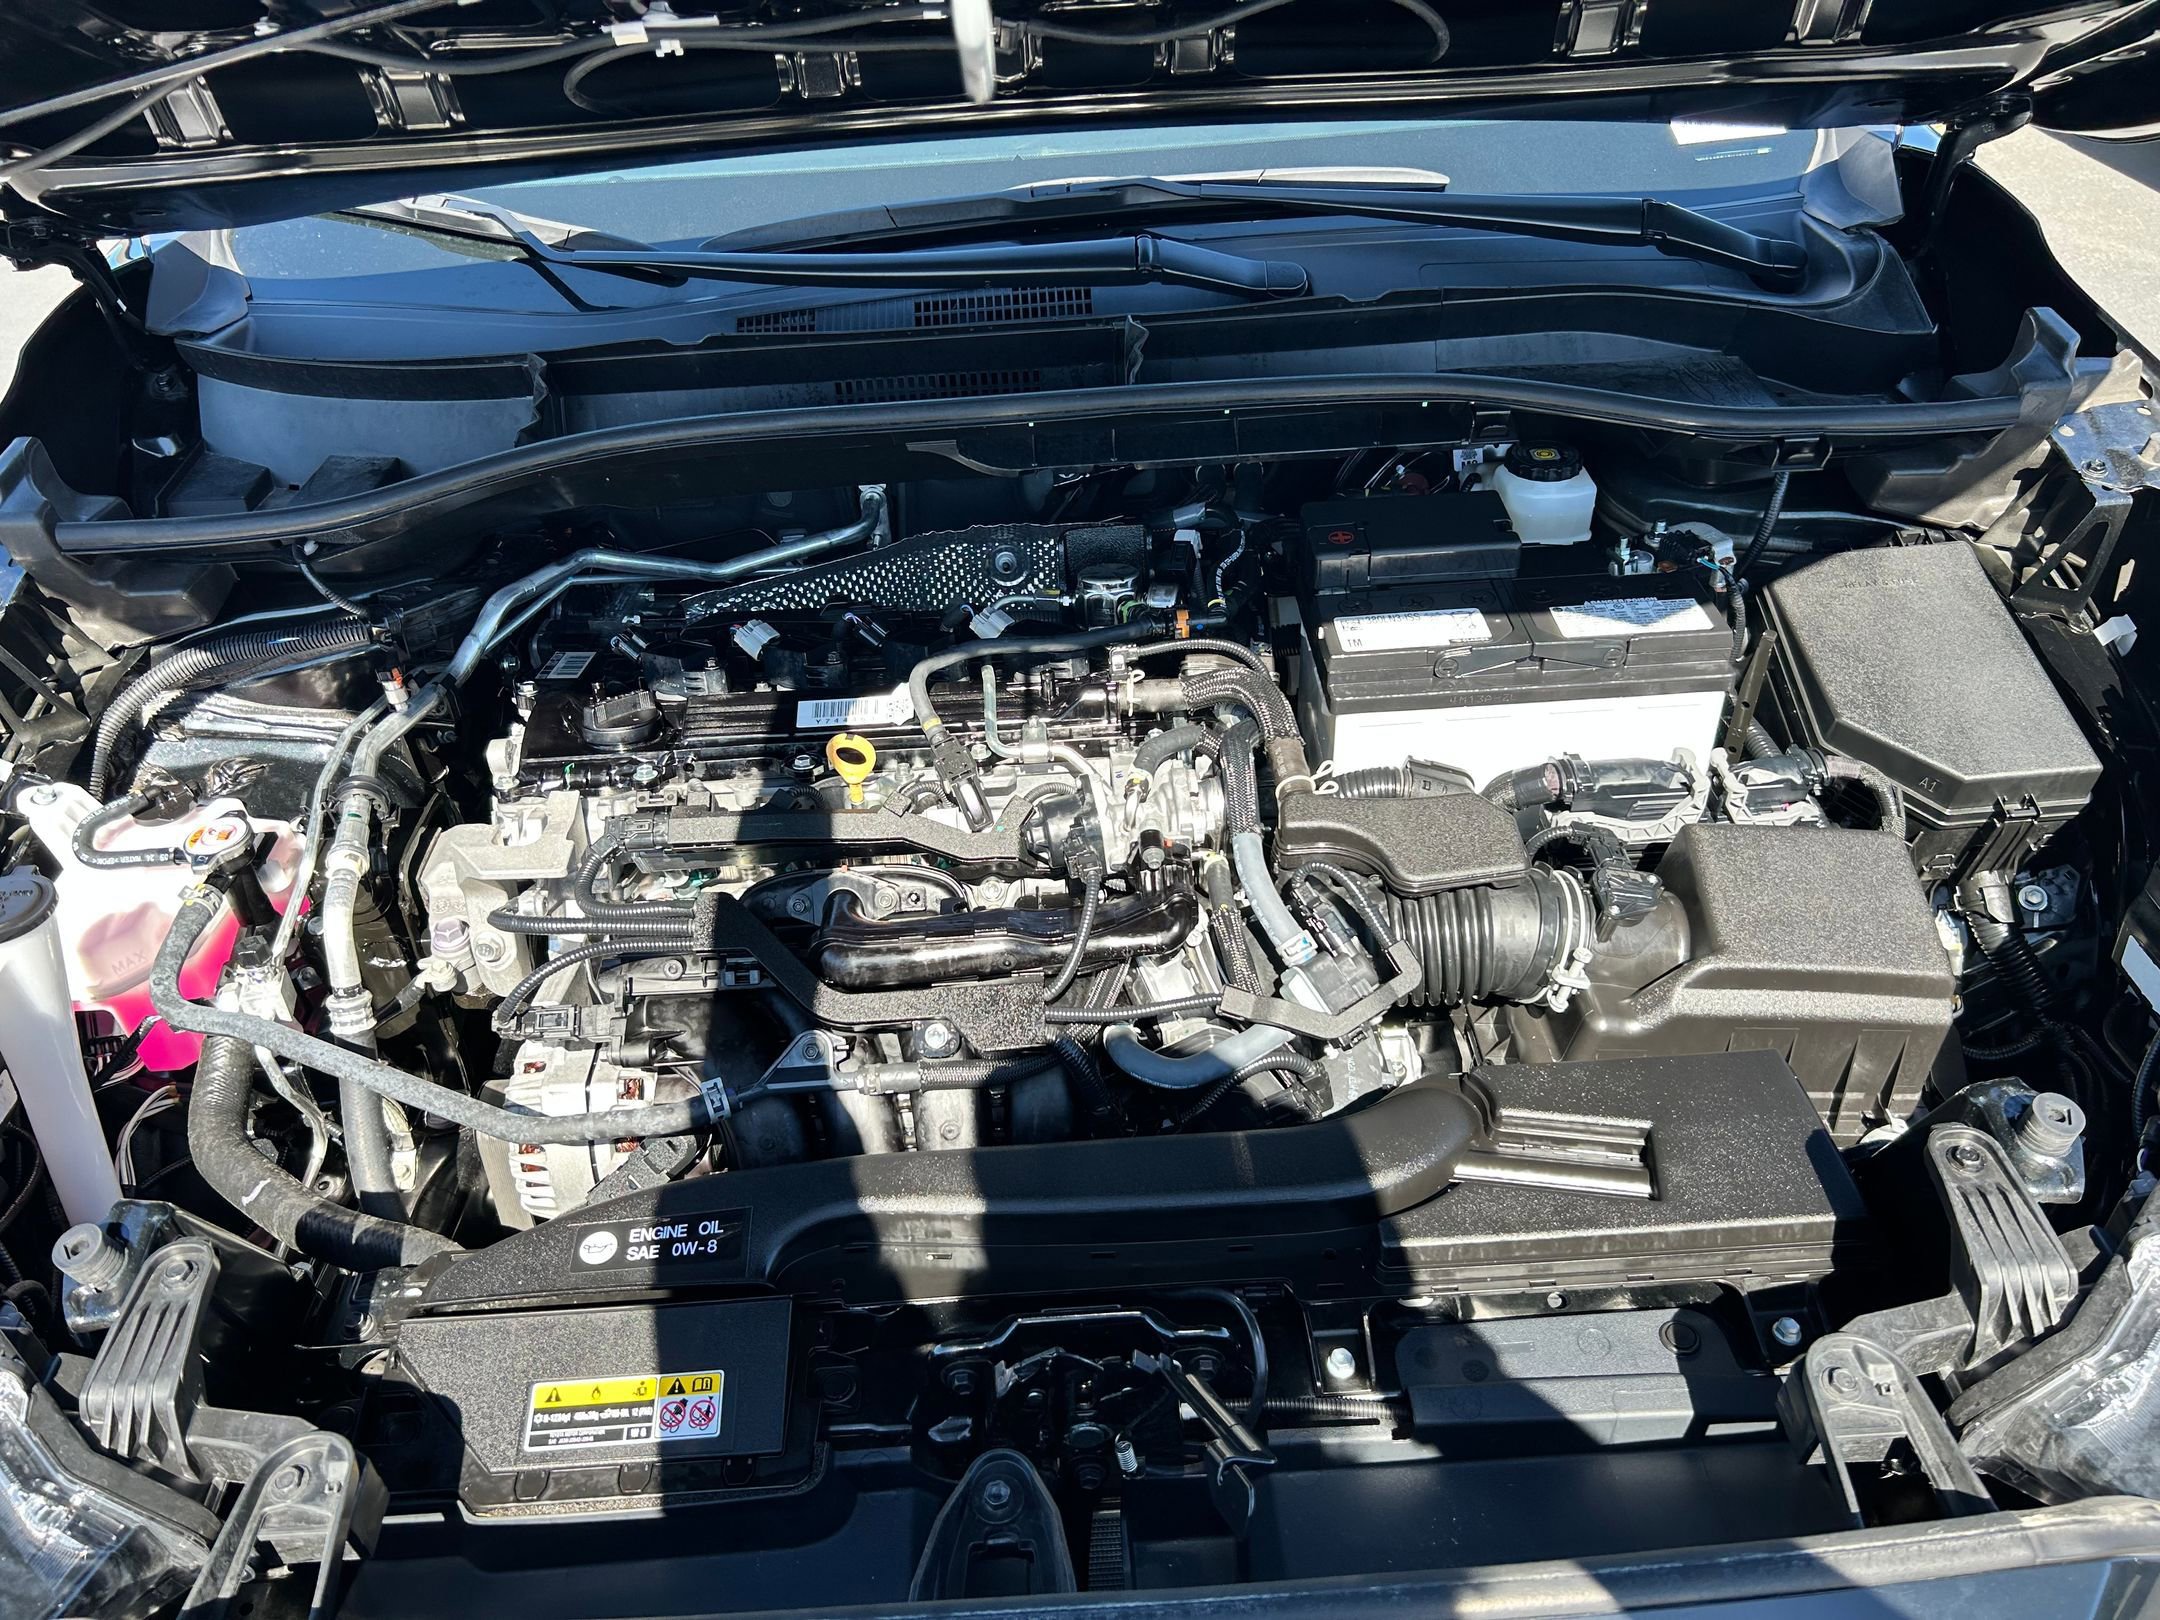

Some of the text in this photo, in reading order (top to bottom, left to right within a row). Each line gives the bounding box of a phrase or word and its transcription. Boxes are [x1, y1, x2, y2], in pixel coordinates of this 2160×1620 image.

[1918, 777, 1937, 793] A1
[112, 950, 148, 976] MAX
[629, 1220, 724, 1243] ENGINE OIL
[626, 1239, 718, 1261] SAE 0W-8
